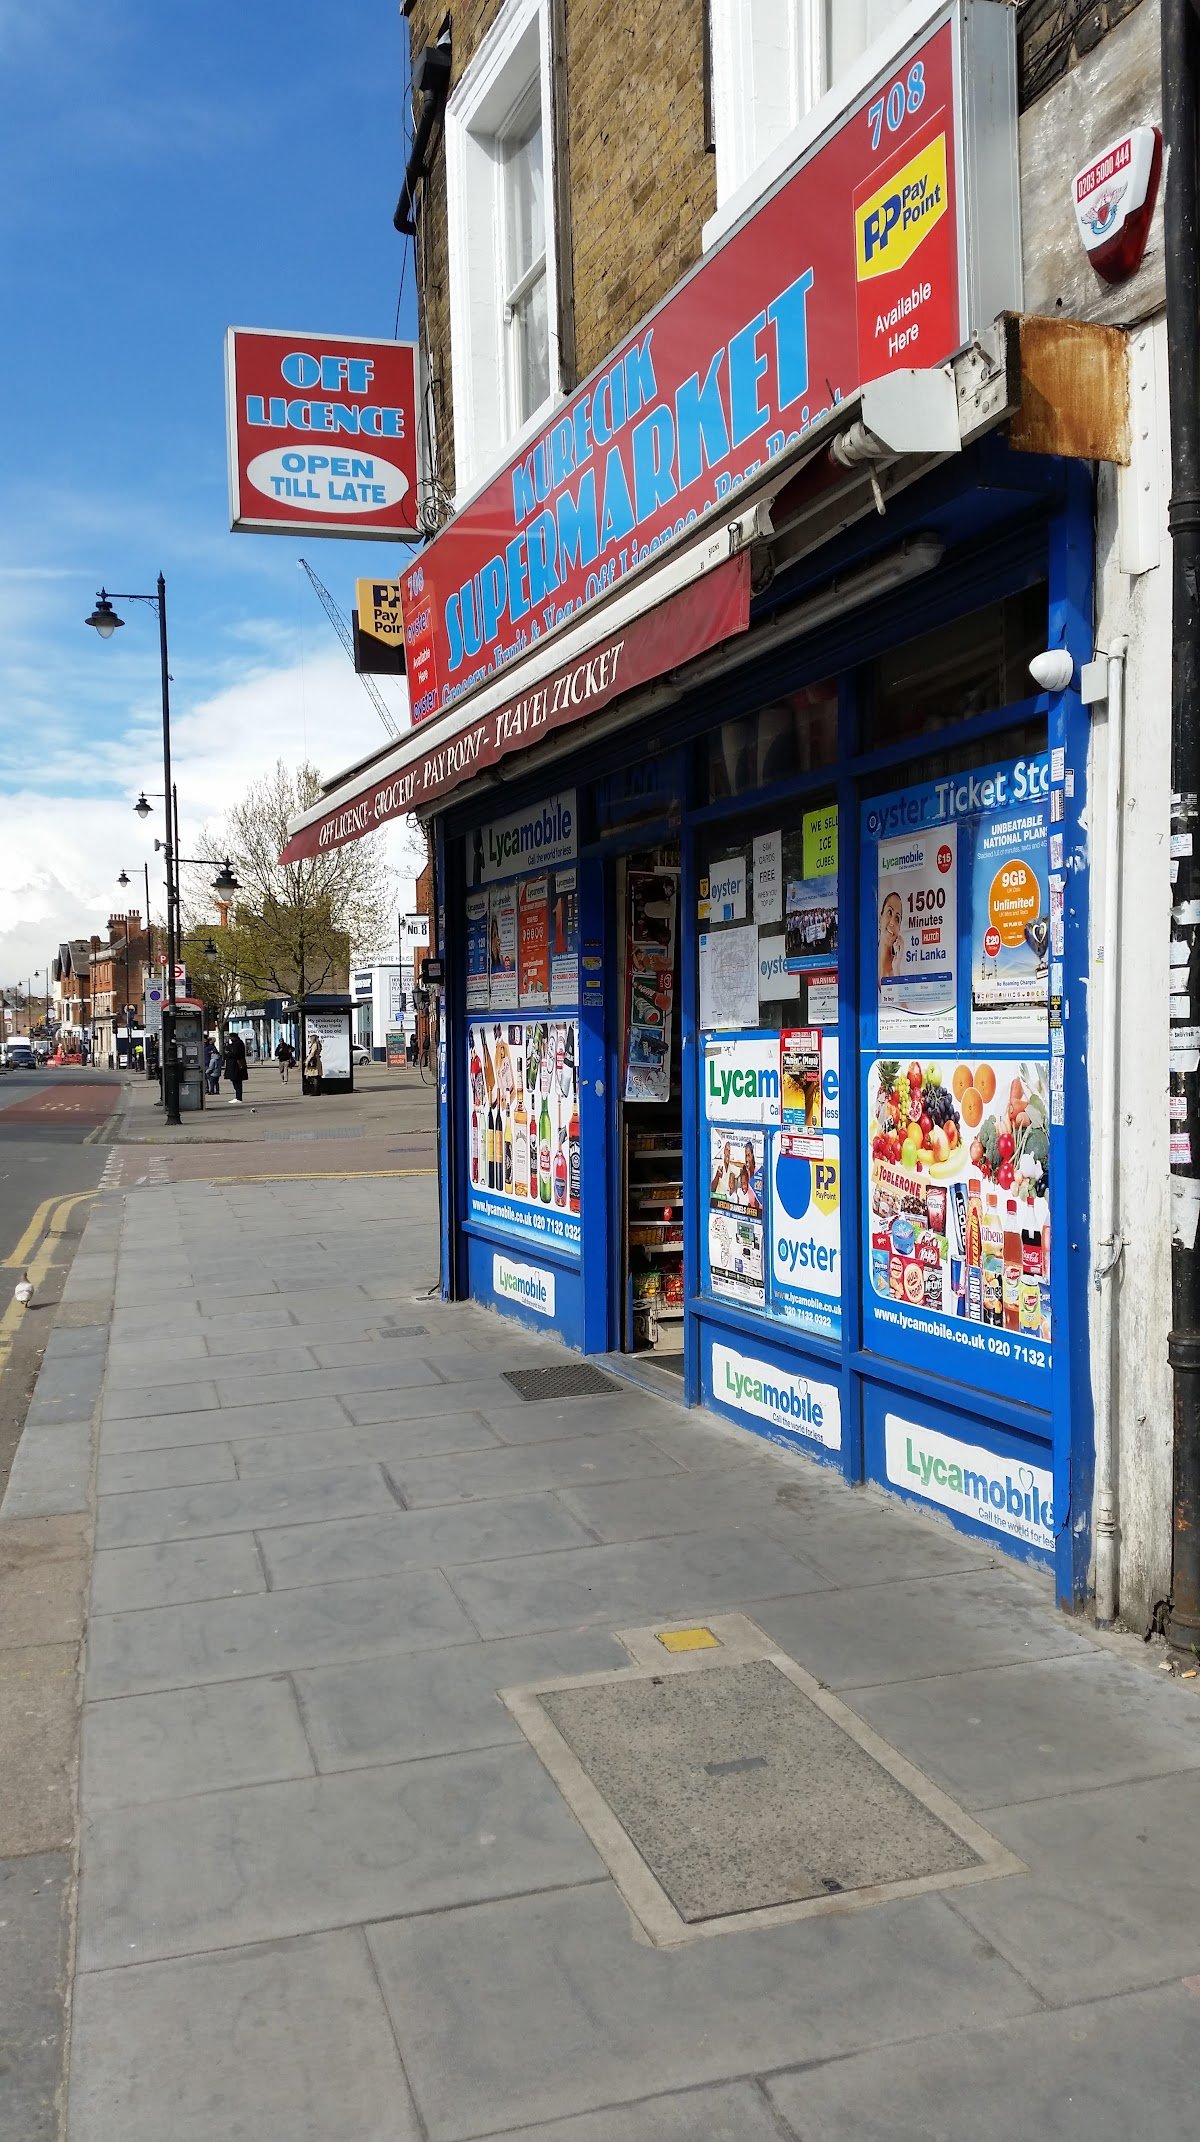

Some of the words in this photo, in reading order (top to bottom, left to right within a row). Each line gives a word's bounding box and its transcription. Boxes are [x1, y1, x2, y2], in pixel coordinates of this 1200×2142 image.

[866, 61, 924, 150] 708
[1079, 171, 1096, 198] 0203
[1096, 158, 1114, 184] 5000
[1115, 148, 1130, 170] 444
[902, 173, 928, 209] Pay
[902, 183, 942, 231] Point
[874, 280, 933, 338] Available
[888, 320, 920, 357] Here
[281, 352, 375, 394] OFF
[246, 395, 405, 438] LICENCE
[513, 329, 659, 526] KURECIK
[282, 453, 374, 478] OPEN
[446, 266, 816, 672] SUPERMARKET
[270, 477, 320, 499] TILL
[328, 481, 387, 504] LATE
[586, 560, 616, 600] Off
[374, 608, 398, 624] Pay
[375, 621, 403, 635] Poin
[413, 647, 431, 669] Available
[418, 668, 429, 684] Here
[374, 778, 416, 819] GROCERY
[423, 755, 446, 789] PAY
[446, 726, 482, 771] POINT
[550, 639, 626, 715] TICKET
[867, 795, 930, 838] oyster
[935, 771, 1007, 820] Ticket
[1013, 761, 1049, 800] Sto
[489, 802, 572, 868] Lycamobile
[811, 820, 823, 833] WE
[825, 815, 839, 829] SELL
[991, 814, 1043, 835] UNBEATABLE
[763, 841, 773, 853] SIM
[819, 836, 833, 850] ICE
[983, 832, 1022, 850] NATIONAL
[528, 855, 536, 866] Call
[543, 849, 555, 862] world
[562, 845, 572, 856] less
[759, 852, 776, 865] CARDS
[816, 855, 836, 869] CUBES
[882, 849, 924, 871] Lycamobile
[938, 852, 951, 866] £15
[759, 869, 776, 884] FREE
[1002, 869, 1027, 888] 9GB
[712, 876, 742, 903] oyster
[758, 890, 770, 901] WHEN
[769, 889, 778, 899] YOU
[907, 887, 946, 913] 1500
[761, 899, 769, 908] TOP
[769, 897, 775, 906] UP
[993, 896, 1035, 912] Unlimited
[422, 924, 428, 936] 8
[908, 914, 944, 930] Minutes
[911, 935, 920, 946] to
[923, 931, 940, 943] HUTCH
[986, 934, 999, 946] £20
[160, 955, 167, 963] P
[905, 949, 918, 963] Sri
[920, 947, 947, 962] Lanka
[761, 954, 788, 980] oyste
[813, 976, 837, 985] WARNING
[1003, 980, 1019, 988] Roaming
[1020, 979, 1037, 987] Charges
[825, 1105, 840, 1120] less
[879, 1165, 922, 1198] TOBLERONE
[816, 1190, 838, 1201] PayPoint
[472, 1199, 532, 1227] www.lycamobile.co.uk
[533, 1213, 546, 1230] 020
[547, 1217, 564, 1236] 7132
[982, 1226, 1004, 1244] Ribena
[778, 1233, 838, 1274] oyster
[499, 1265, 547, 1303] Lycamobile
[774, 1289, 843, 1316] www.lycamobile.co.uk
[785, 1304, 797, 1319] 020
[797, 1308, 815, 1324] 7132
[815, 1311, 833, 1328] 0322
[874, 1307, 986, 1352] www.lycamobile.co.uk
[988, 1336, 1011, 1358] 020
[1014, 1345, 1046, 1369] 7132
[726, 1361, 824, 1428] Lycamobile
[772, 1412, 783, 1425] Call
[782, 1416, 791, 1427] the
[791, 1420, 805, 1433] world
[805, 1425, 813, 1437] for
[813, 1429, 824, 1442] less
[906, 1437, 1054, 1532] Lycamobile
[978, 1506, 993, 1523] Call
[993, 1515, 1006, 1530] the
[1007, 1520, 1030, 1538] world
[1030, 1528, 1042, 1543] for
[1042, 1533, 1055, 1549] les
